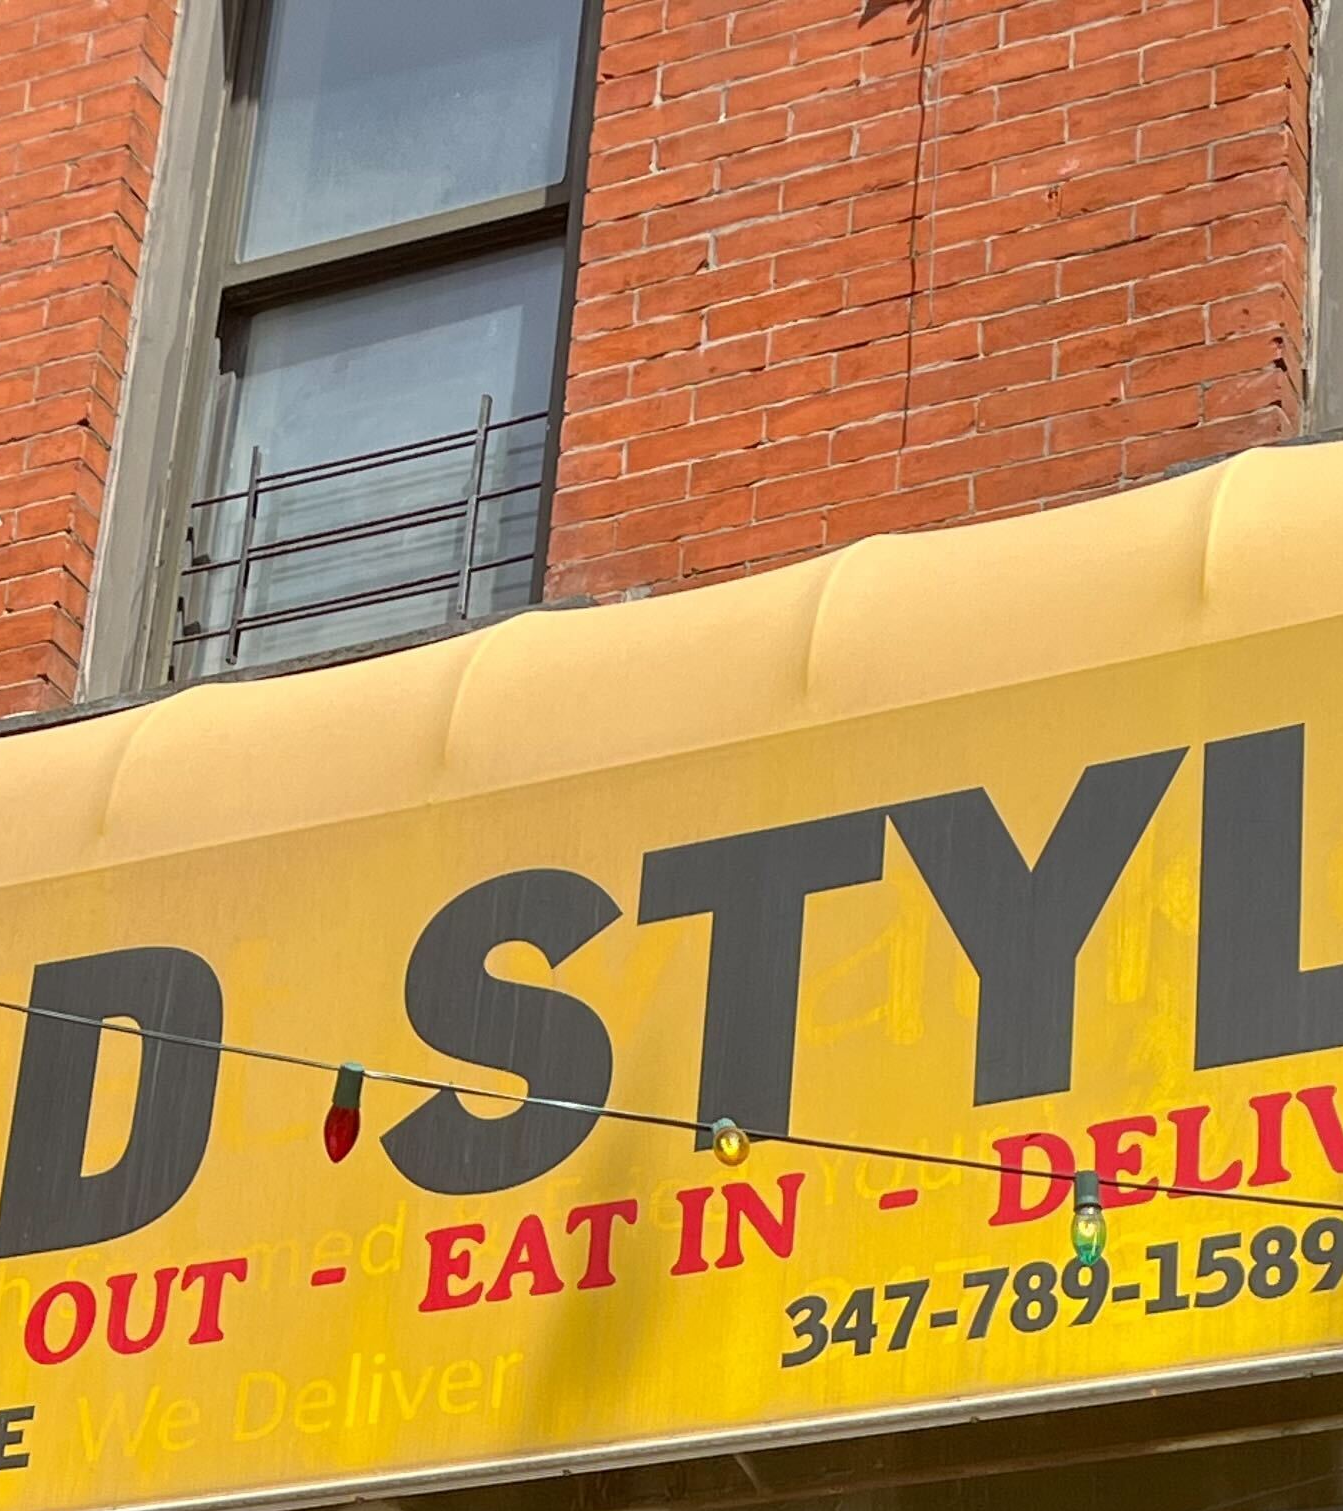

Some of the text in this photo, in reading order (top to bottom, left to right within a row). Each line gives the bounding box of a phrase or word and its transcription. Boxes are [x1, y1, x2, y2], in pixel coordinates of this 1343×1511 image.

[23, 1258, 248, 1364] OUT
[417, 1197, 640, 1315] EAT
[672, 1172, 806, 1275] IN
[230, 1341, 526, 1442] Deliver
